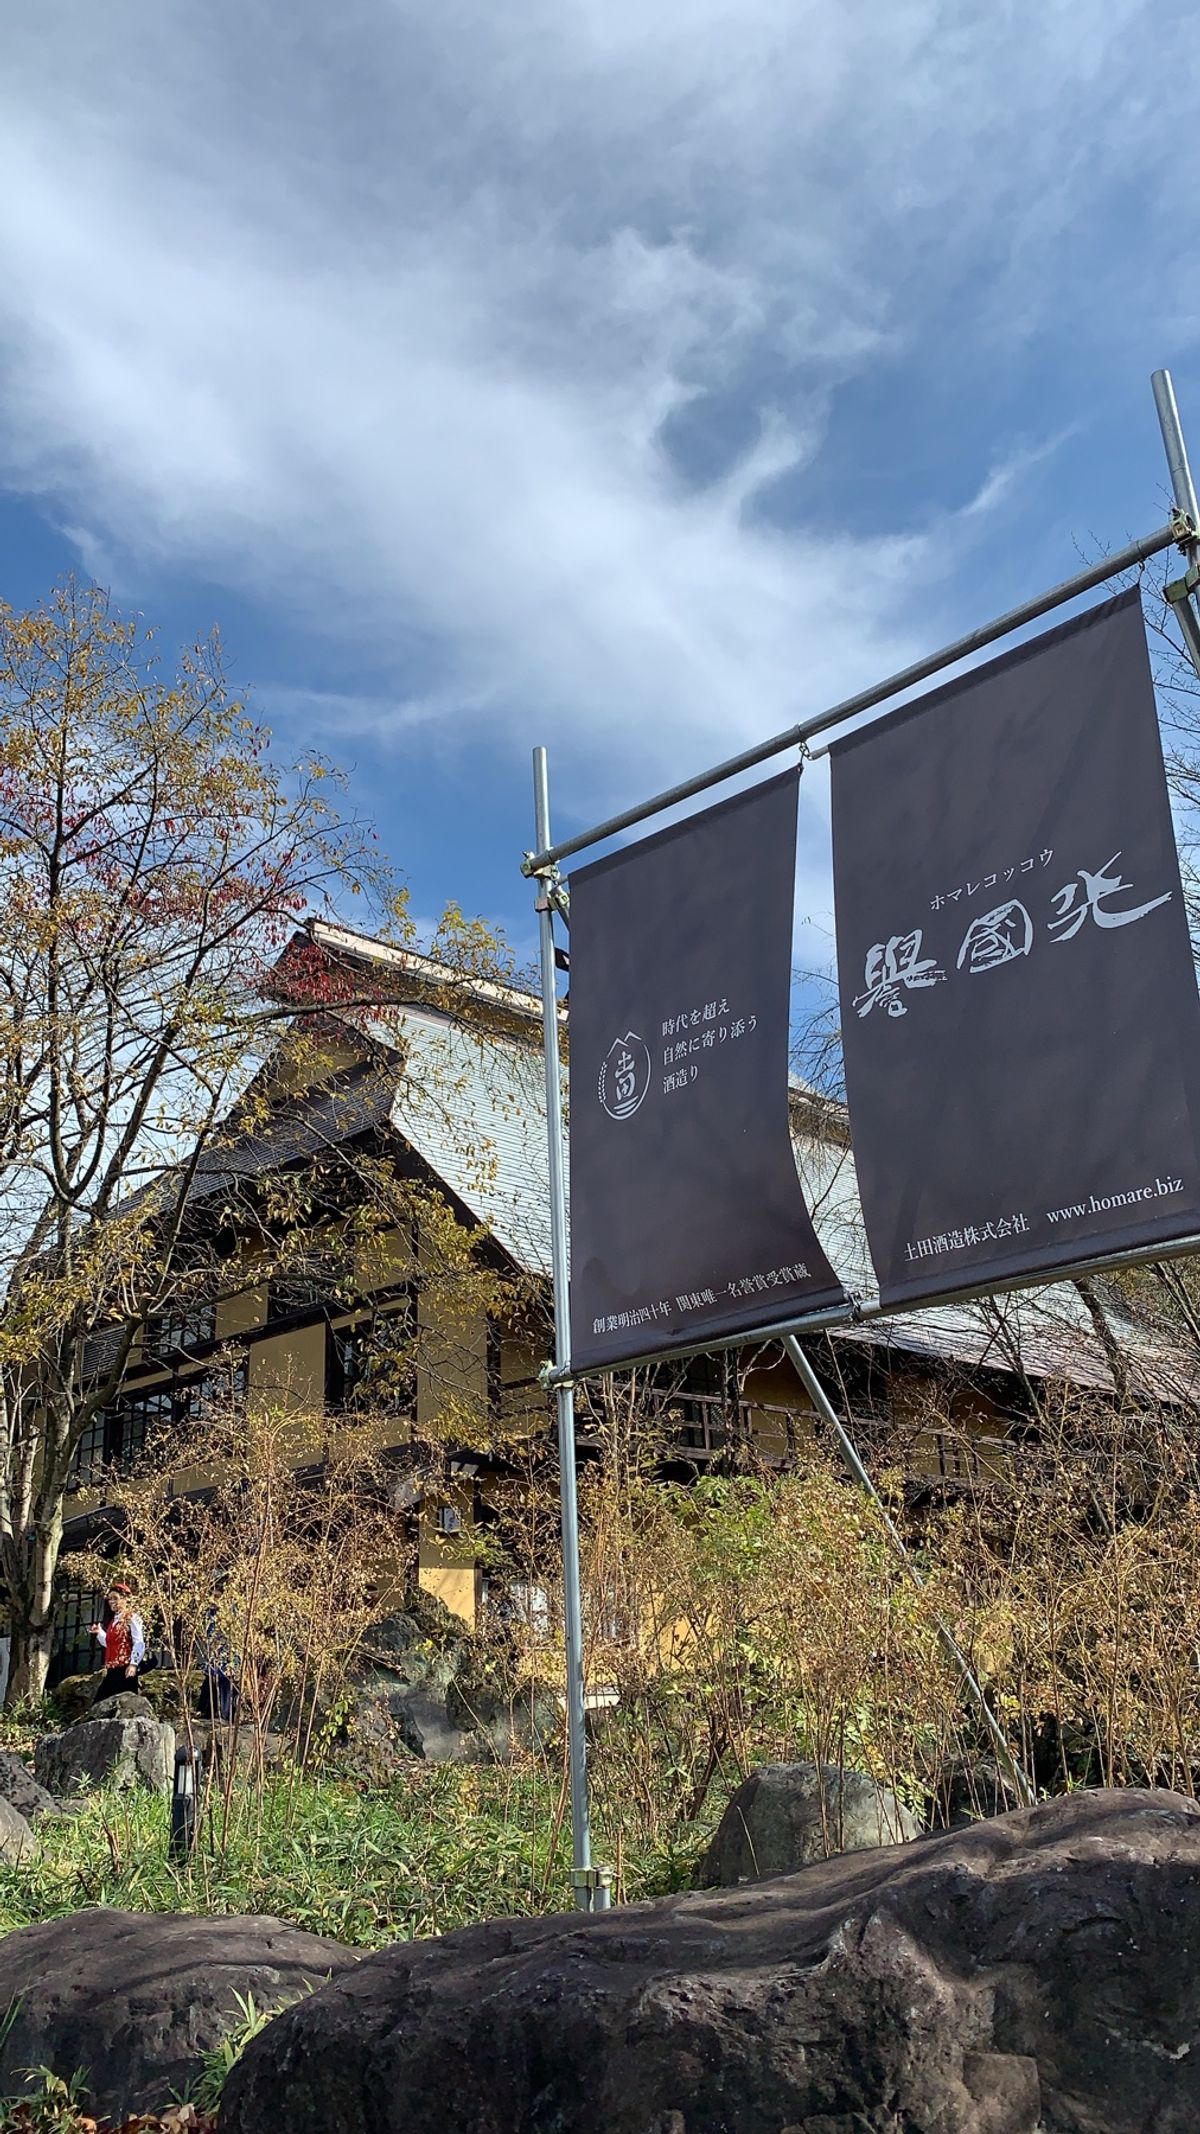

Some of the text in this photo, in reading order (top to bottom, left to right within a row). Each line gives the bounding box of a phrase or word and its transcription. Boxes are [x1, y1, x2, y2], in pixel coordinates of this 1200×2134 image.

[930, 848, 1054, 910] ホマレコッコウ
[662, 998, 731, 1037] 時代を超え
[663, 1014, 758, 1066] 自然に寄り添う
[663, 1064, 699, 1094] 酒造り
[904, 1176, 1184, 1262] 土田酒造株式会社 www.homare.biz
[592, 1300, 672, 1334] 創業明治四十年
